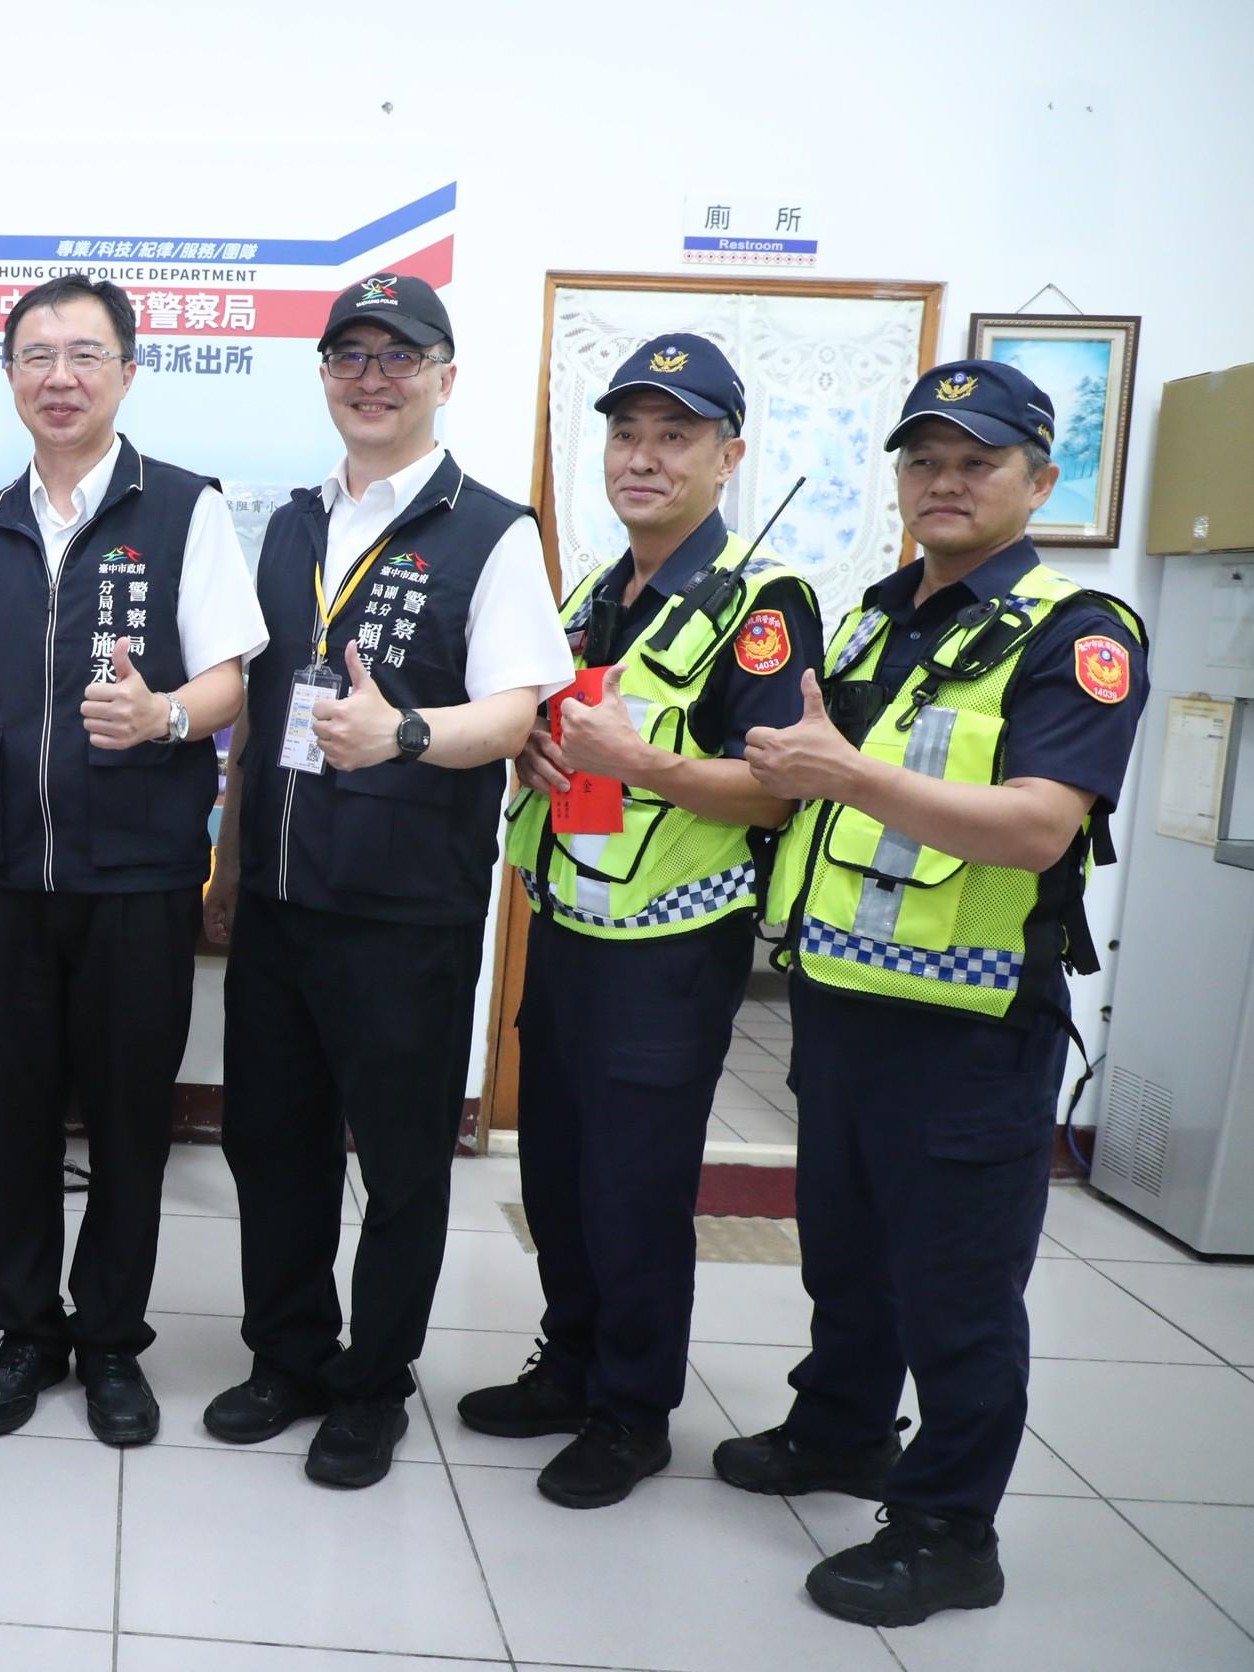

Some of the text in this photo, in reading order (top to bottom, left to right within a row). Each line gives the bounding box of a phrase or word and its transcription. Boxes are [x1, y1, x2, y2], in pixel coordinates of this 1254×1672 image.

[704, 204, 802, 233] 廁所
[56, 240, 259, 260] 專業/科技/紀律/服務/團隊
[719, 239, 784, 251] Restroom
[48, 267, 83, 279] CITY
[88, 267, 144, 280] POLICE
[149, 268, 257, 282] DEPARTMENT
[98, 563, 146, 575] 臺中市政府
[379, 565, 430, 585] 臺中市政府
[98, 580, 115, 626] 分局長
[126, 581, 148, 657] 警察局
[381, 589, 428, 669] 警察局
[754, 658, 780, 671] 14033
[1093, 687, 1118, 700] 14039
